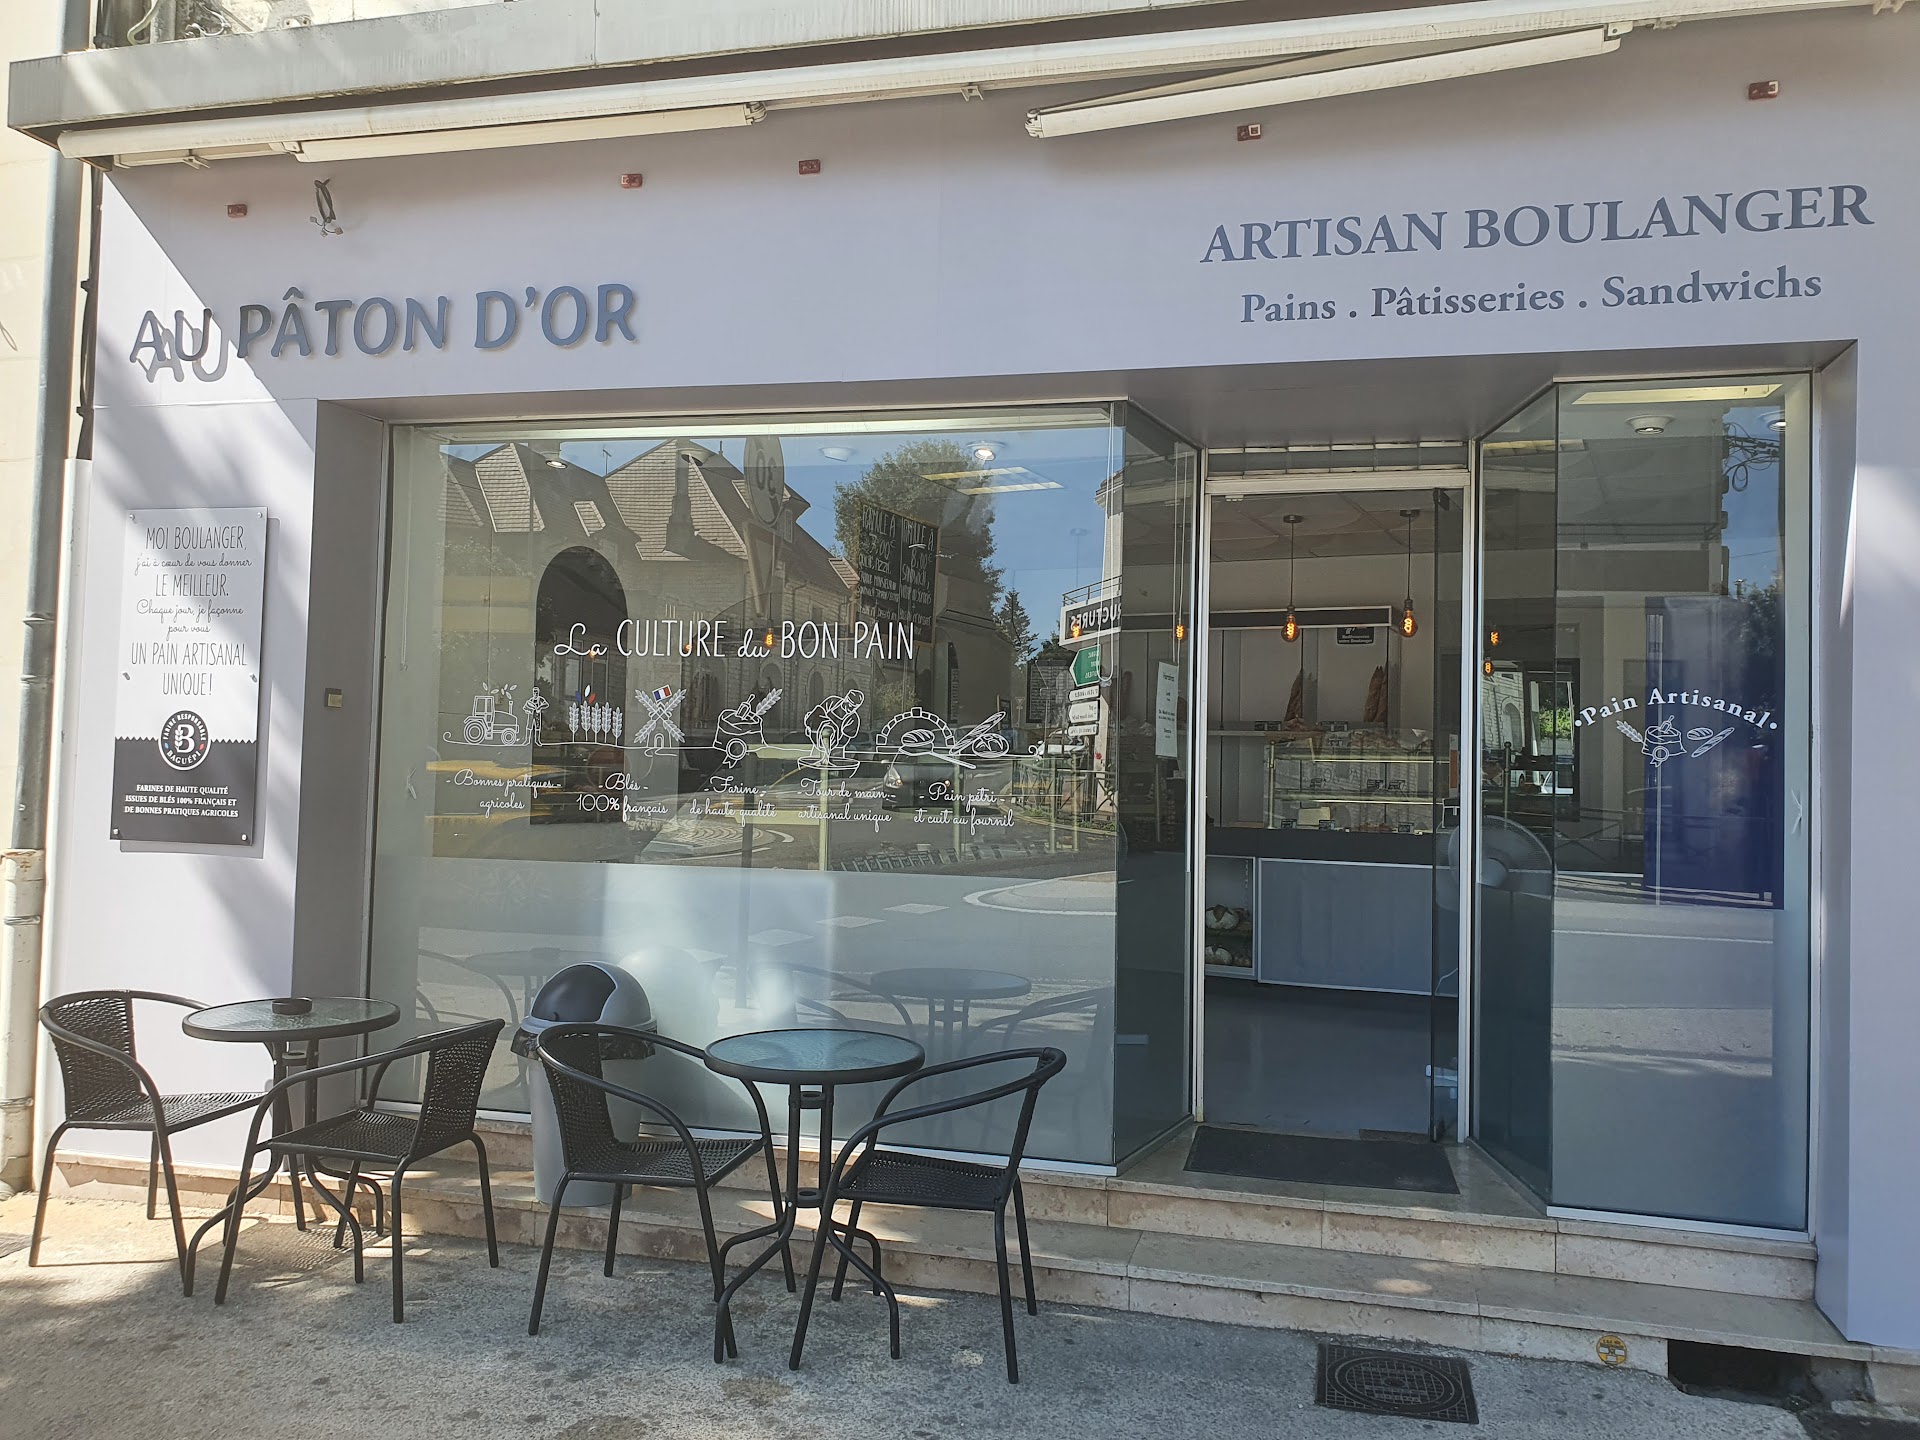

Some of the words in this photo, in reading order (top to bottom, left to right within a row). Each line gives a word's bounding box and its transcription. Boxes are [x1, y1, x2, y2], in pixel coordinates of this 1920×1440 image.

[1200, 211, 1448, 264] ARTISAN
[1464, 183, 1876, 250] BOULANGER
[1241, 293, 1336, 323] Pains
[1371, 283, 1566, 318] Pâtisseries
[1601, 265, 1823, 308] Sandwichs
[129, 308, 214, 364] AU
[236, 286, 450, 358] PÂTON
[145, 526, 169, 550] MOI
[174, 525, 247, 550] BOULANGER,
[184, 553, 195, 567] de
[197, 559, 217, 567] vous
[219, 553, 252, 567] donner
[155, 574, 169, 597] LE
[172, 573, 229, 597] MEILLEUR.
[137, 598, 173, 623] Chaque
[195, 604, 206, 623] je
[207, 599, 244, 623] façonne
[166, 624, 189, 641] pour
[190, 625, 211, 633] vous
[553, 622, 608, 658] La
[615, 618, 728, 658] CULTURE
[736, 627, 771, 659] du
[780, 619, 839, 660] BON
[853, 620, 915, 661] PAIN
[131, 642, 147, 665] UN
[152, 642, 178, 665] PAIN
[182, 642, 248, 666] ARTISANAL
[1579, 696, 1639, 727] Pain
[1647, 687, 1772, 730] Artisanal
[175, 724, 195, 753] B
[167, 750, 201, 765] BAGUÉPI
[136, 784, 164, 793] FARINES
[165, 785, 175, 793] DE
[175, 785, 198, 794] HAUTE
[199, 786, 228, 795] QUALITÉ
[454, 768, 504, 787] Bonnes
[504, 772, 554, 798] pratiques
[604, 772, 641, 791] Blés
[709, 775, 759, 796] Farine
[801, 777, 838, 798] Tour
[838, 779, 852, 798] de
[854, 787, 888, 798] main
[148, 795, 158, 803] DE
[159, 794, 175, 804] BLÉS
[176, 796, 193, 804] 100%
[194, 797, 226, 807] FRANÇAIS
[479, 793, 526, 818] agricoles
[576, 793, 620, 812] 100%
[622, 796, 669, 822] français
[928, 781, 964, 802] Pain
[965, 787, 998, 812] pétri
[135, 806, 162, 814] BONNES
[163, 807, 200, 817] PRATIQUES
[201, 808, 239, 818] AGRICOLES
[689, 798, 703, 815] de
[704, 798, 737, 816] haute
[739, 801, 777, 827] qualité
[797, 802, 851, 822] artisanal
[853, 812, 892, 832] unique
[913, 808, 927, 824] et
[928, 808, 953, 825] cuit
[953, 813, 968, 825] au
[970, 807, 1015, 836] fournil
